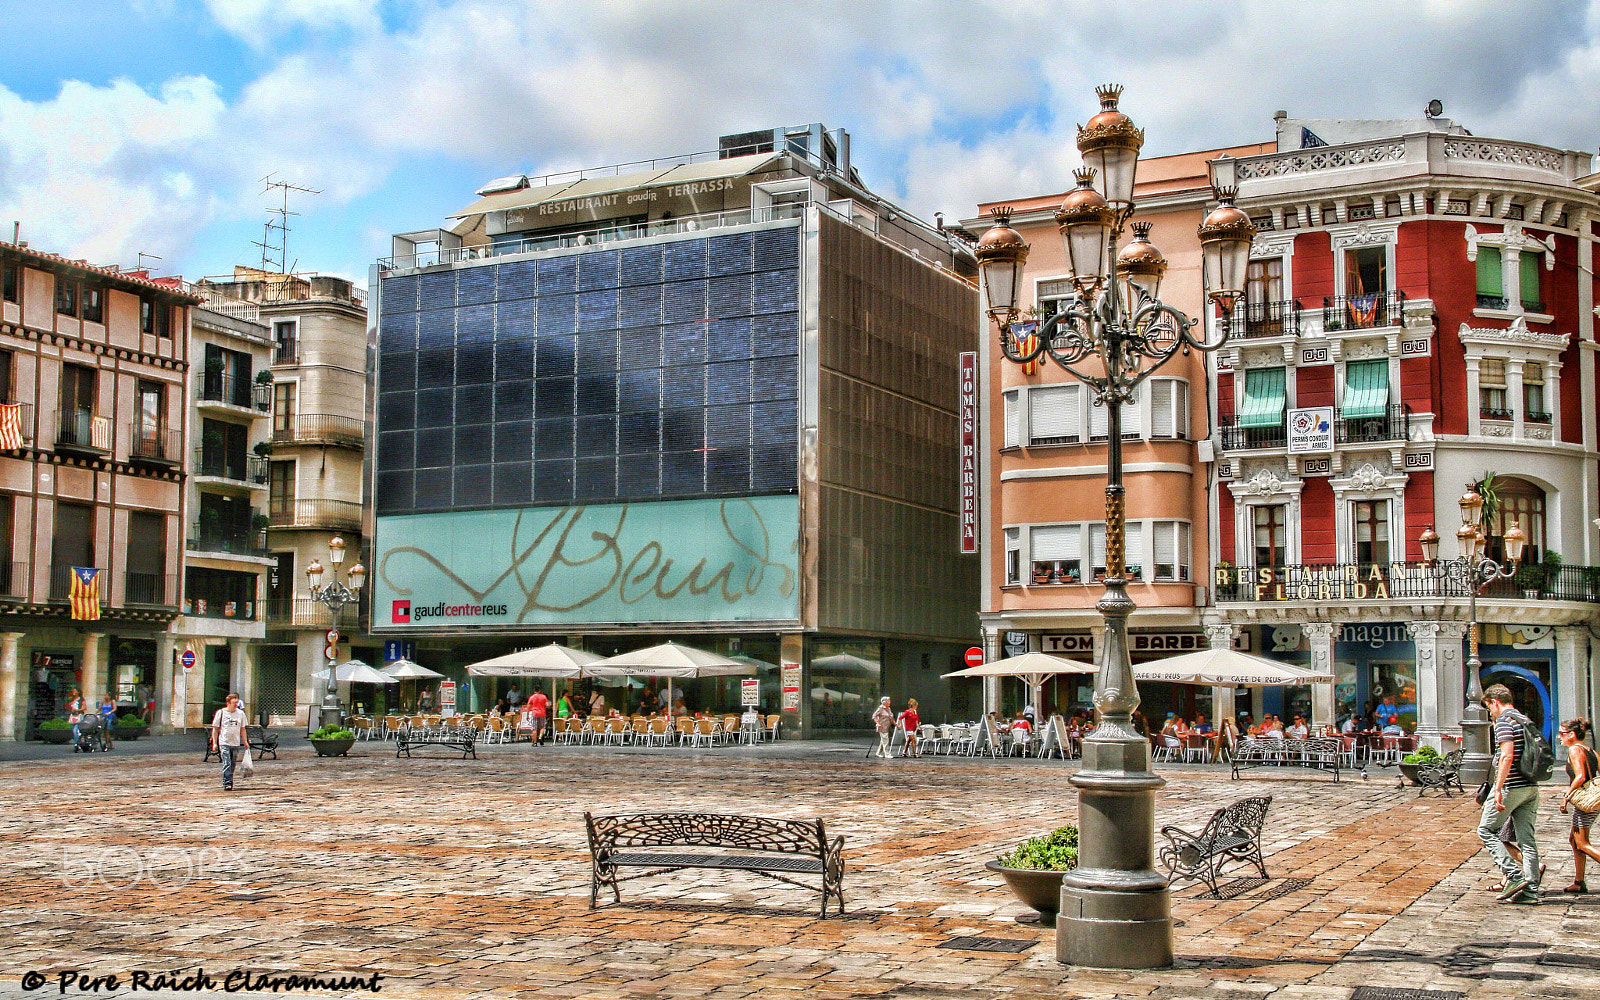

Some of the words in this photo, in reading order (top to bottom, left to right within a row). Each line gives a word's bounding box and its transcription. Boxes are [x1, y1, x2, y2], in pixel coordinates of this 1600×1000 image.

[540, 193, 619, 216] RESTAURANT
[666, 177, 734, 198] TERRASSA
[271, 556, 279, 589] OTLET
[1216, 562, 1430, 585] RESTAURANT
[1255, 582, 1389, 601] FLORIDA
[1049, 636, 1094, 650] TOM
